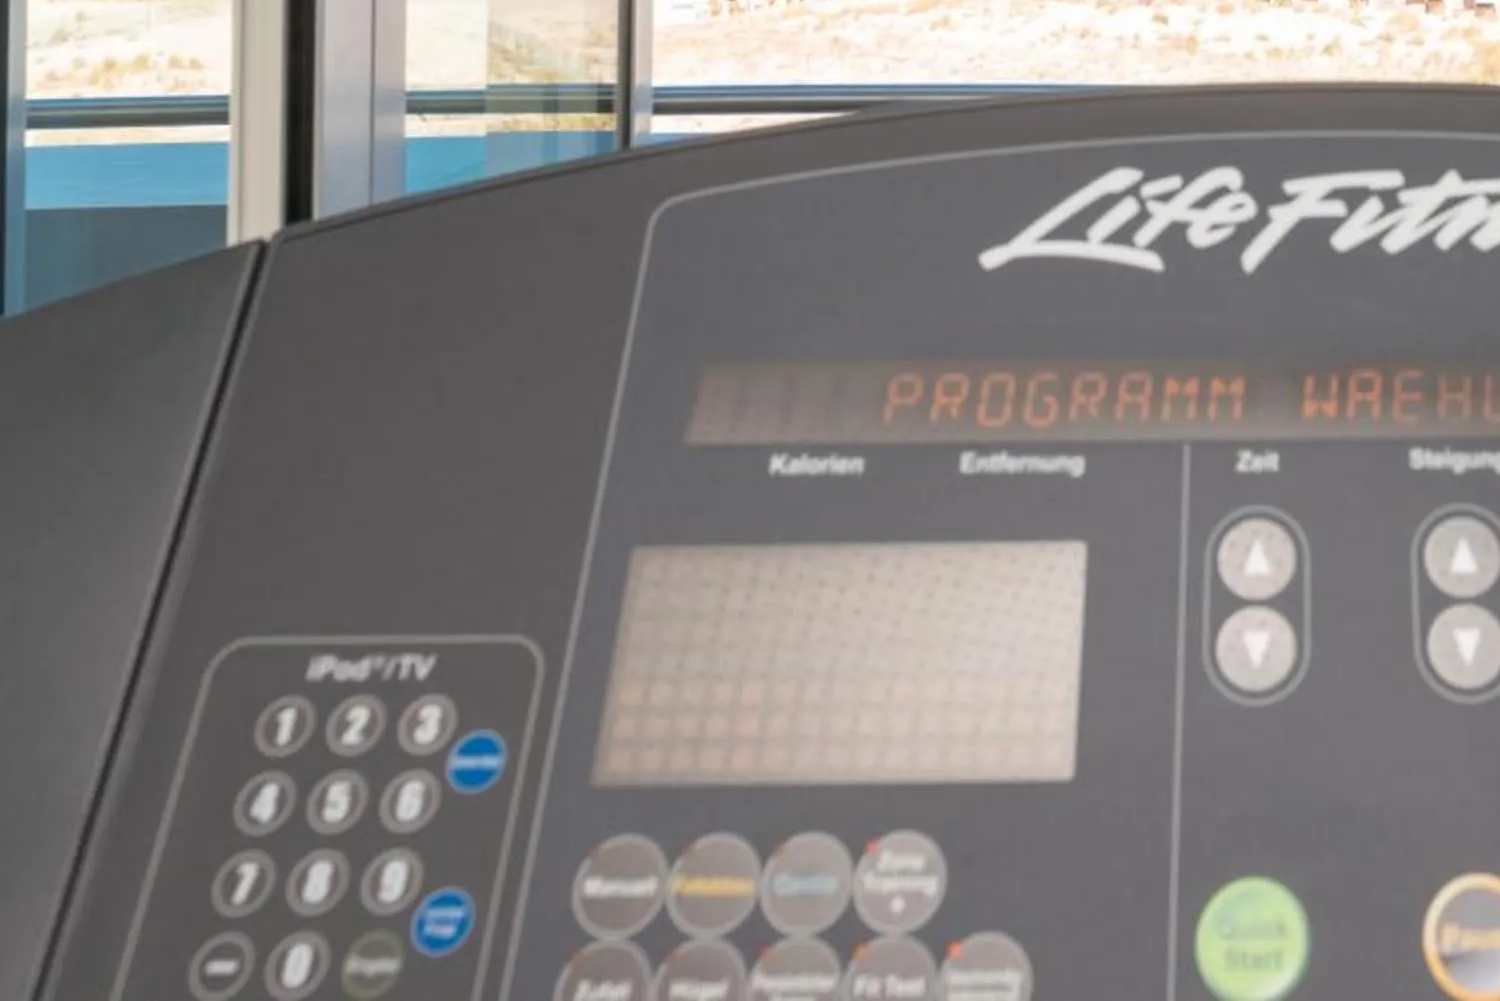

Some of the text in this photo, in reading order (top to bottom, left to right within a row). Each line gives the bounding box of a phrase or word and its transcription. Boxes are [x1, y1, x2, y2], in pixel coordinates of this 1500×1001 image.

[978, 166, 1258, 271] Life
[883, 371, 1247, 429] PROGRAMM
[768, 452, 865, 476] Kalorien
[959, 451, 1086, 478] Entfernung
[1235, 450, 1280, 474] Zeit
[275, 703, 442, 747] 1 2 3
[250, 781, 280, 824] 4
[321, 780, 351, 822] 5
